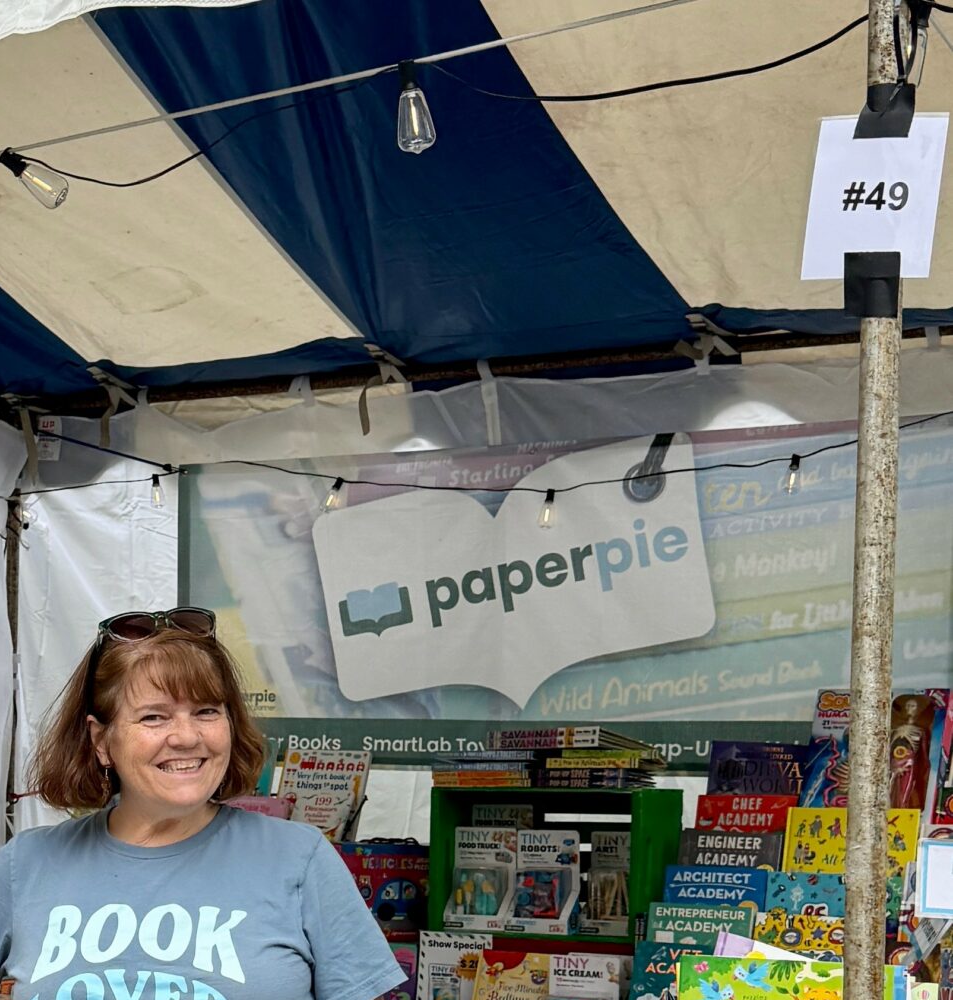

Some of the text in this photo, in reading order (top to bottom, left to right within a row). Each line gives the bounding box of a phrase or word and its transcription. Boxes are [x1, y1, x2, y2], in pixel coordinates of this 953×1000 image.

[842, 181, 909, 211] #49
[710, 506, 831, 539] ACTIVITY
[424, 518, 689, 628] paperpie
[541, 669, 773, 716] Wild Animals Sound
[501, 729, 558, 739] SAVANNAH
[288, 734, 342, 751] Books
[362, 735, 452, 754] SmartLab
[500, 738, 557, 749] SAVANNAH
[297, 771, 346, 782] Very first book
[296, 781, 349, 791] things spot
[732, 797, 763, 811] CHEF
[717, 813, 774, 827] ACADEMY
[458, 830, 490, 842] TINY
[521, 833, 552, 845] TINY
[597, 835, 629, 846] TINY
[696, 835, 762, 850] ENGINEER
[458, 842, 477, 850] FOOD
[521, 845, 561, 853] ROBOTS!
[695, 853, 758, 867] ACADEMY
[673, 871, 752, 885] ARCHITECT
[677, 888, 746, 900] ACADEMY
[655, 906, 746, 921] ENTREPRENEUR
[665, 920, 733, 933] ACADEMY
[30, 903, 247, 984] BOOK
[428, 939, 486, 951] Show Special
[553, 956, 589, 969] TINY
[553, 969, 604, 979] ICE CREAM!
